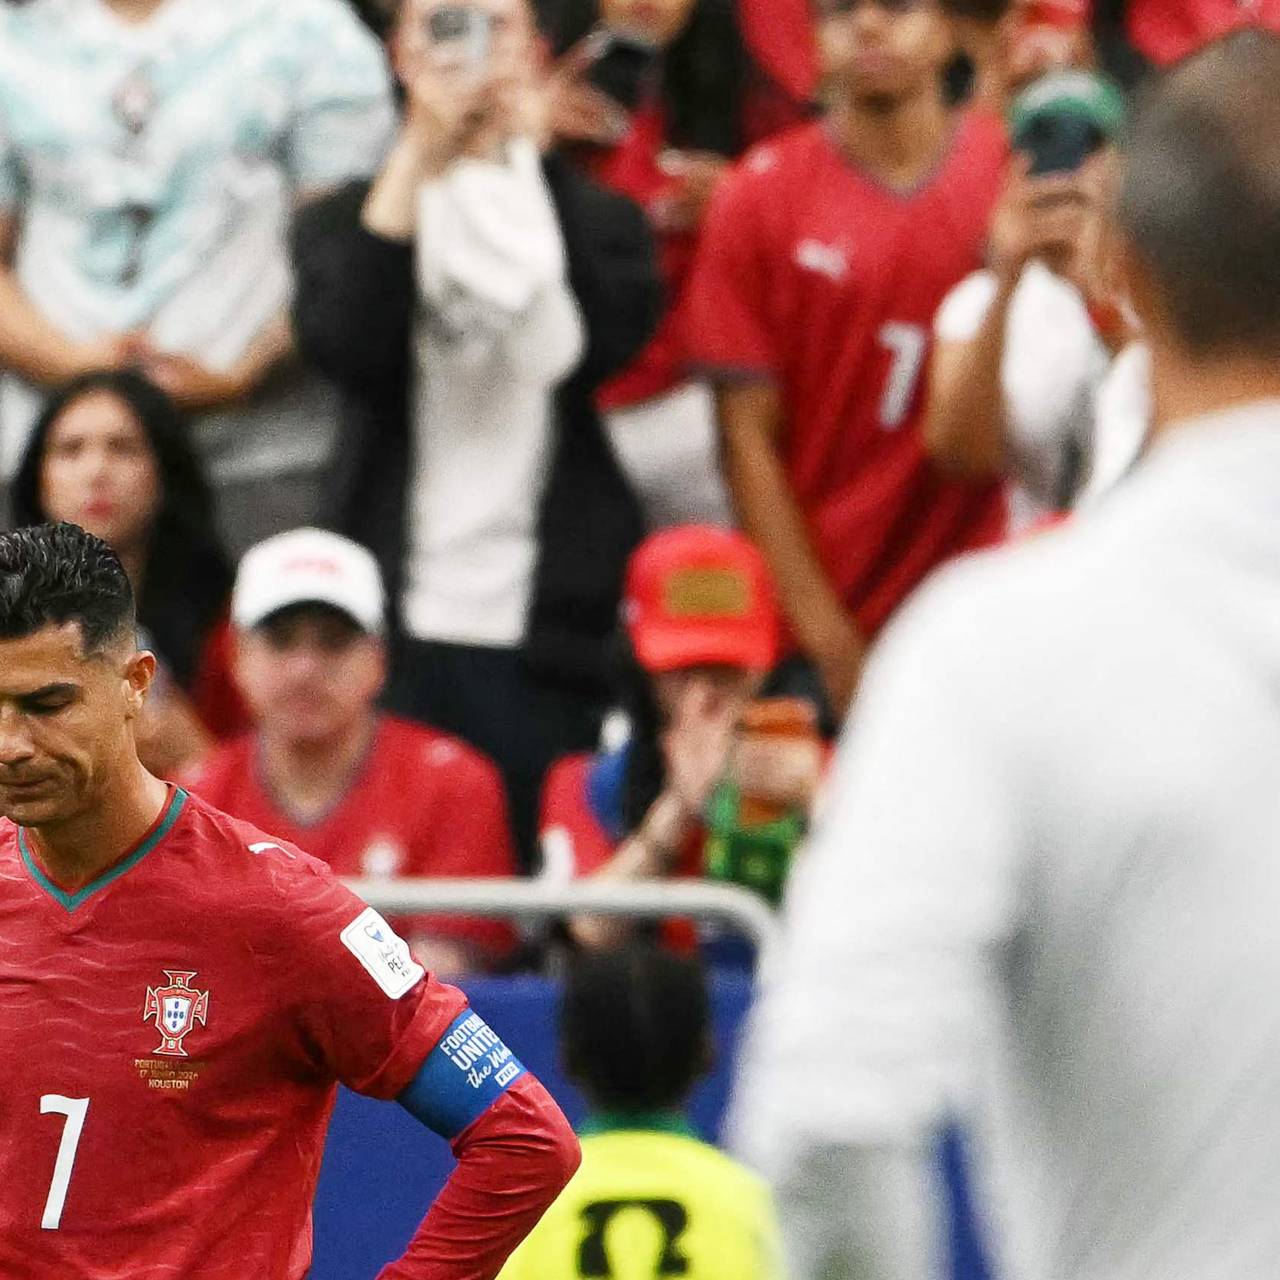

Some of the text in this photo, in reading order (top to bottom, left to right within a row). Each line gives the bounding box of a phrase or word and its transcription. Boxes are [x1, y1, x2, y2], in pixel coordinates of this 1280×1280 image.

[877, 321, 925, 430] 7
[148, 1079, 190, 1089] HOUSTON
[466, 1067, 492, 1088] the
[39, 1093, 91, 1230] 7
